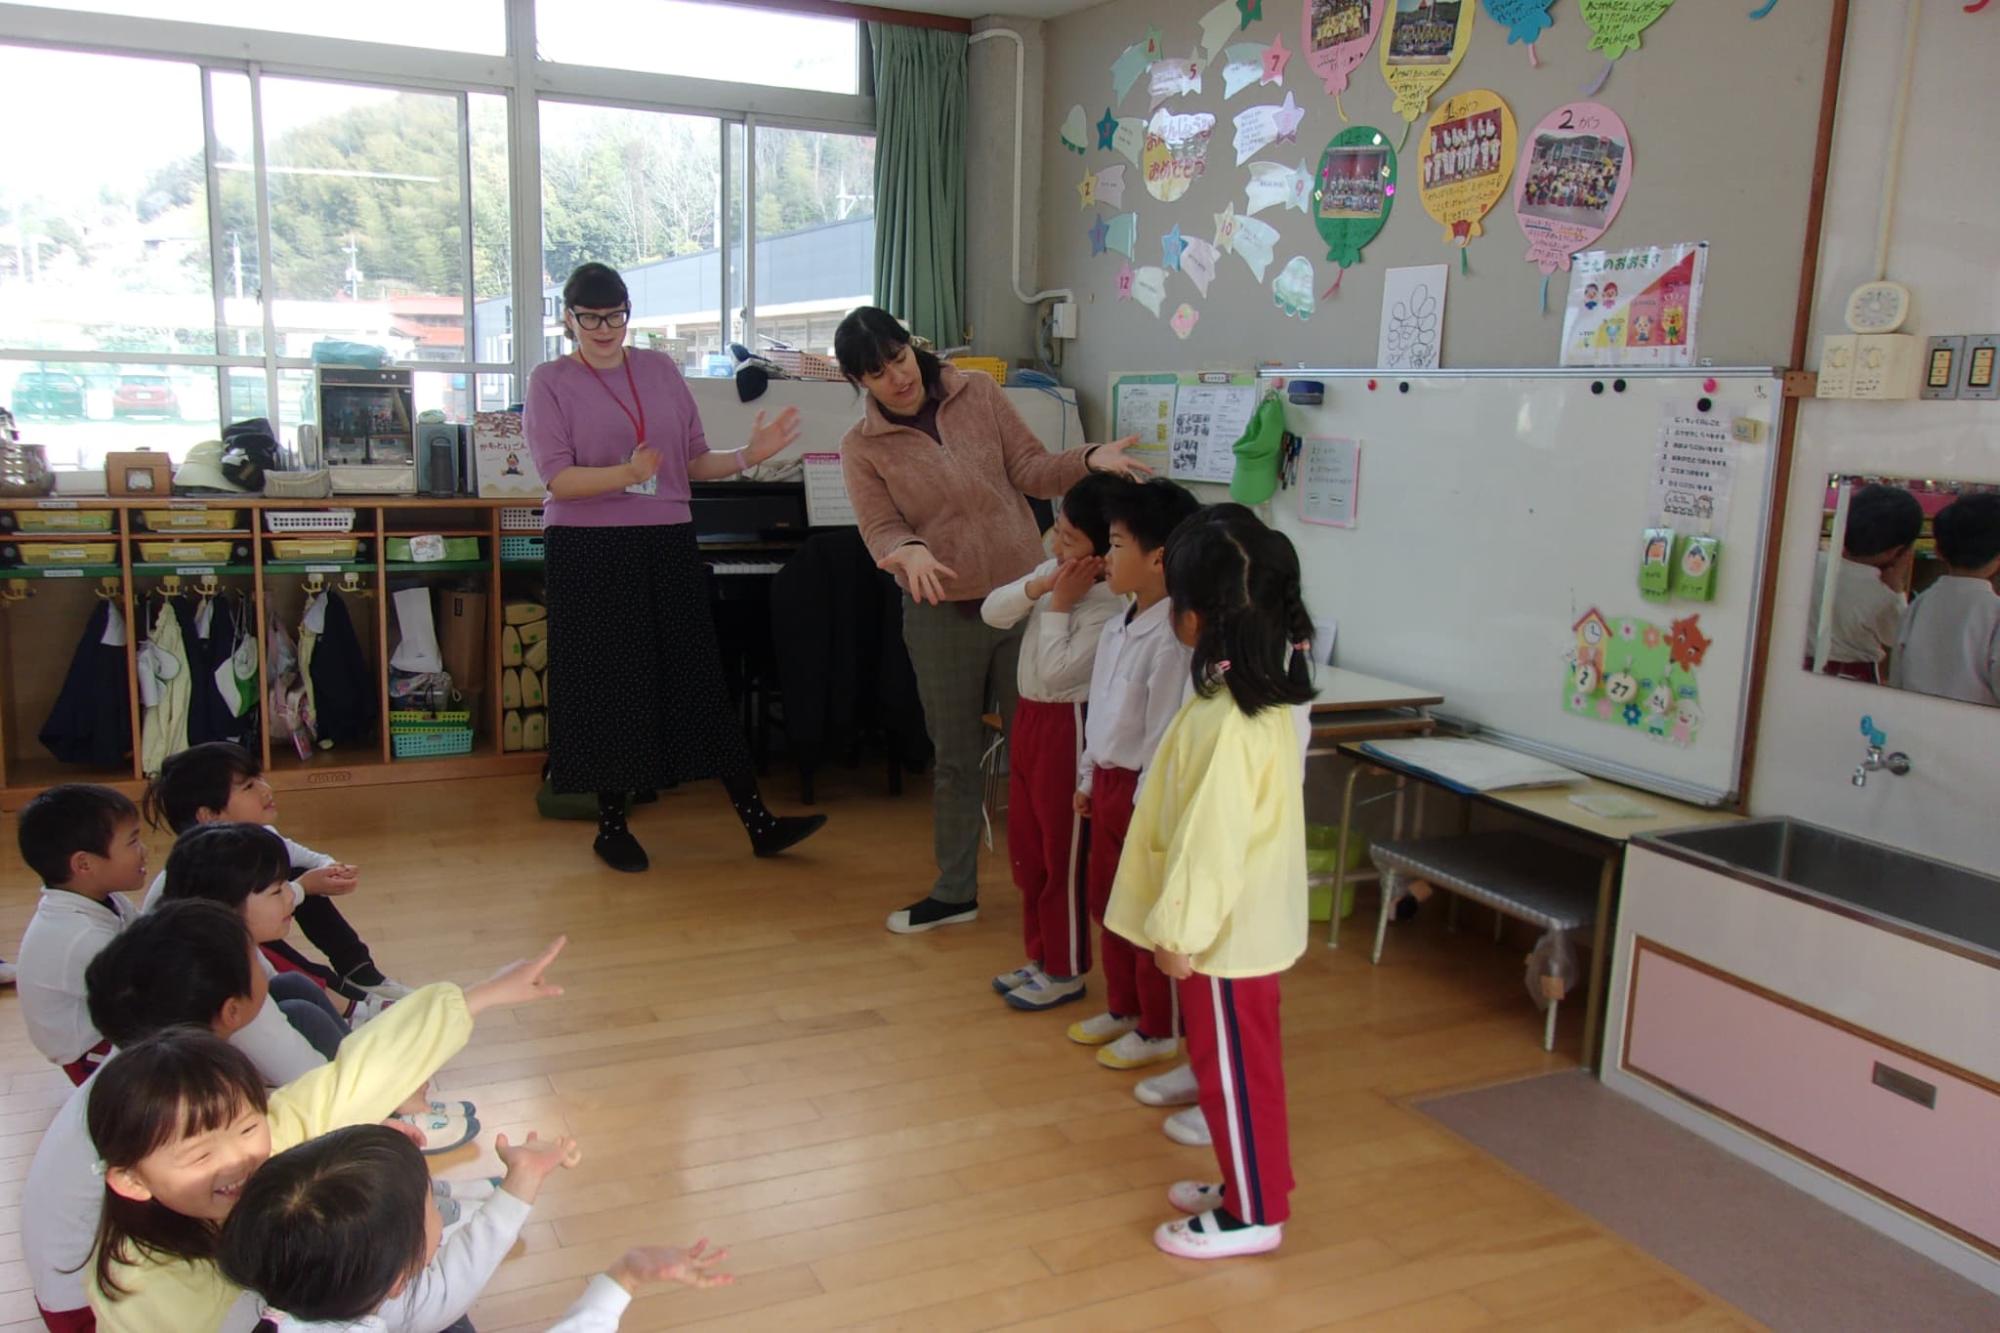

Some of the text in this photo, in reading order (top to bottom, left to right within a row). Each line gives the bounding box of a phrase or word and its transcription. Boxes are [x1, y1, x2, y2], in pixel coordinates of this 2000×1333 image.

[1189, 63, 1199, 80] 5
[1271, 54, 1281, 72] 7
[1294, 178, 1304, 195] 9
[1220, 219, 1234, 237] 10
[1580, 252, 1661, 273] こえのおおきさ
[1119, 275, 1130, 291] 12
[1579, 670, 1589, 686] 2
[1610, 681, 1629, 698] 27
